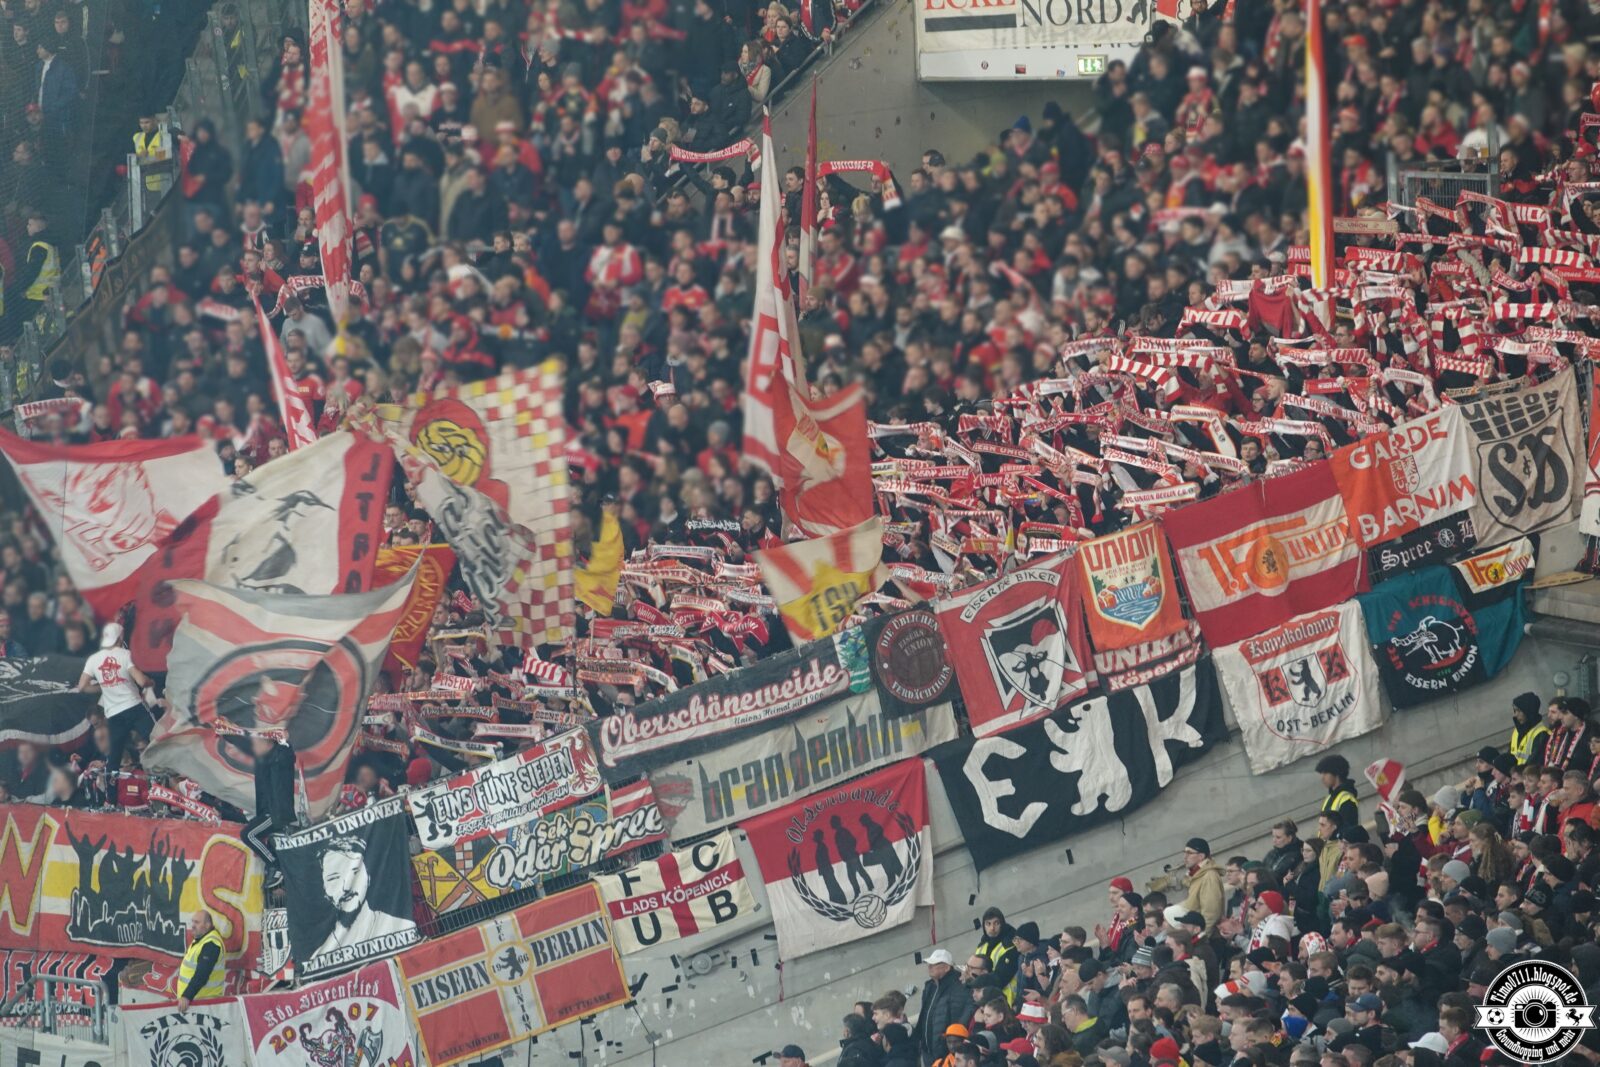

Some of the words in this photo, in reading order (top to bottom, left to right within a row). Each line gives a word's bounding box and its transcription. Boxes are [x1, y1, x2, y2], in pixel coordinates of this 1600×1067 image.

[1020, 0, 1122, 27] NORD
[831, 160, 875, 171] UNIONER
[1350, 416, 1448, 469] GARDE
[980, 474, 1002, 487] Union
[1358, 474, 1476, 543] BARNIM
[1082, 529, 1156, 572] UNION
[1381, 540, 1433, 571] Spree
[1503, 554, 1532, 577] UNION
[1015, 569, 1056, 584] BIKER
[881, 628, 894, 648] DIE
[892, 613, 939, 631] ÜBLICHEN
[898, 629, 925, 649] EISERN
[903, 637, 934, 656] UNION
[1405, 673, 1447, 690] EISERN
[1452, 645, 1478, 682] UNION
[600, 658, 840, 750] Oberschöneweide
[733, 712, 763, 726] Unions
[762, 703, 791, 721] Heimat
[804, 690, 826, 708] 1906
[431, 792, 474, 823] EINS
[472, 769, 519, 812] FÜNF
[516, 747, 575, 794] SIEBEN
[274, 826, 333, 850] EINMAL
[334, 800, 402, 835] UNIONER
[486, 836, 567, 890] Oder
[567, 802, 667, 867] Spree
[619, 868, 641, 897] F
[692, 841, 720, 873] C
[620, 896, 659, 916] LADS
[661, 871, 732, 907] KÖPENICK
[631, 911, 662, 946] U
[707, 889, 739, 925] B
[411, 960, 491, 1010] EISERN
[530, 917, 609, 968] BERLIN
[492, 963, 502, 974] 19
[140, 1012, 231, 1039] SIXTY
[513, 985, 533, 1033] UNION
